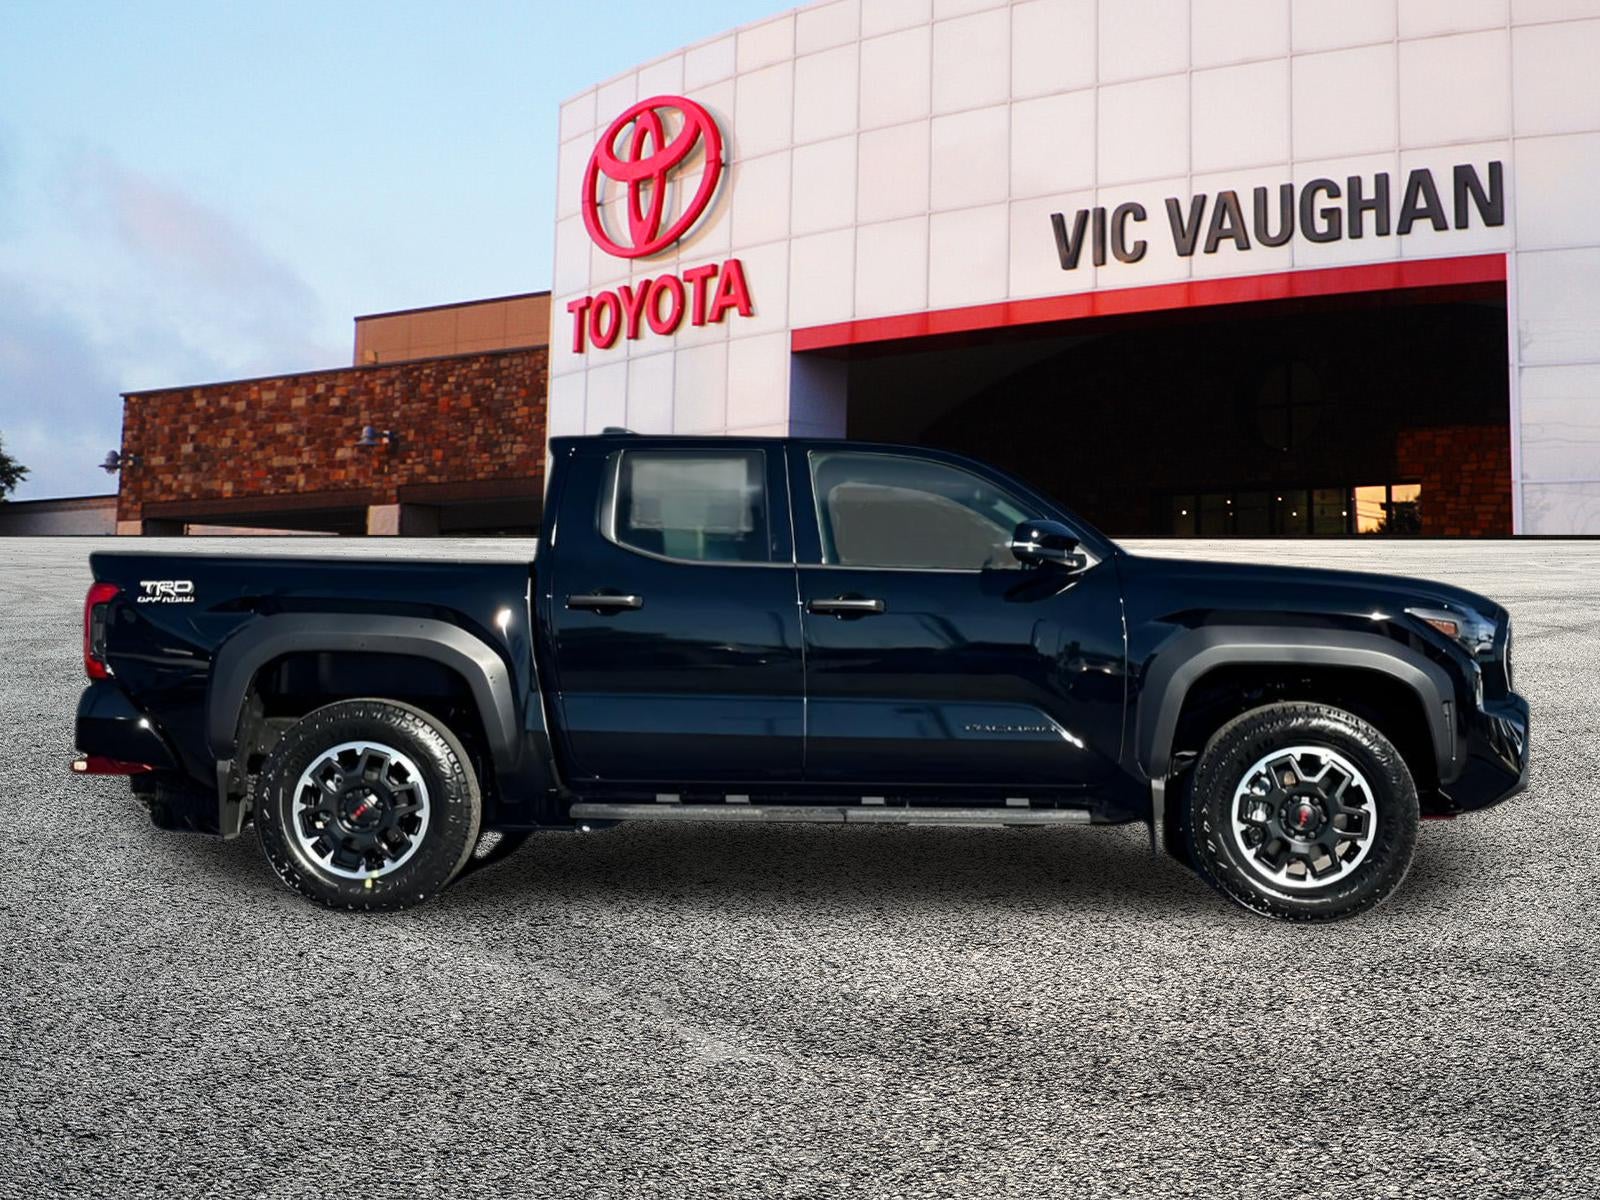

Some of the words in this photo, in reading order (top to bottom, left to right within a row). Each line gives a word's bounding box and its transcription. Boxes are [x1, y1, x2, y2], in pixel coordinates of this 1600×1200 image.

[1050, 201, 1147, 271] VIC
[1164, 161, 1506, 257] VAUGHAN
[567, 258, 755, 354] TOYOTA
[139, 580, 194, 596] TRD
